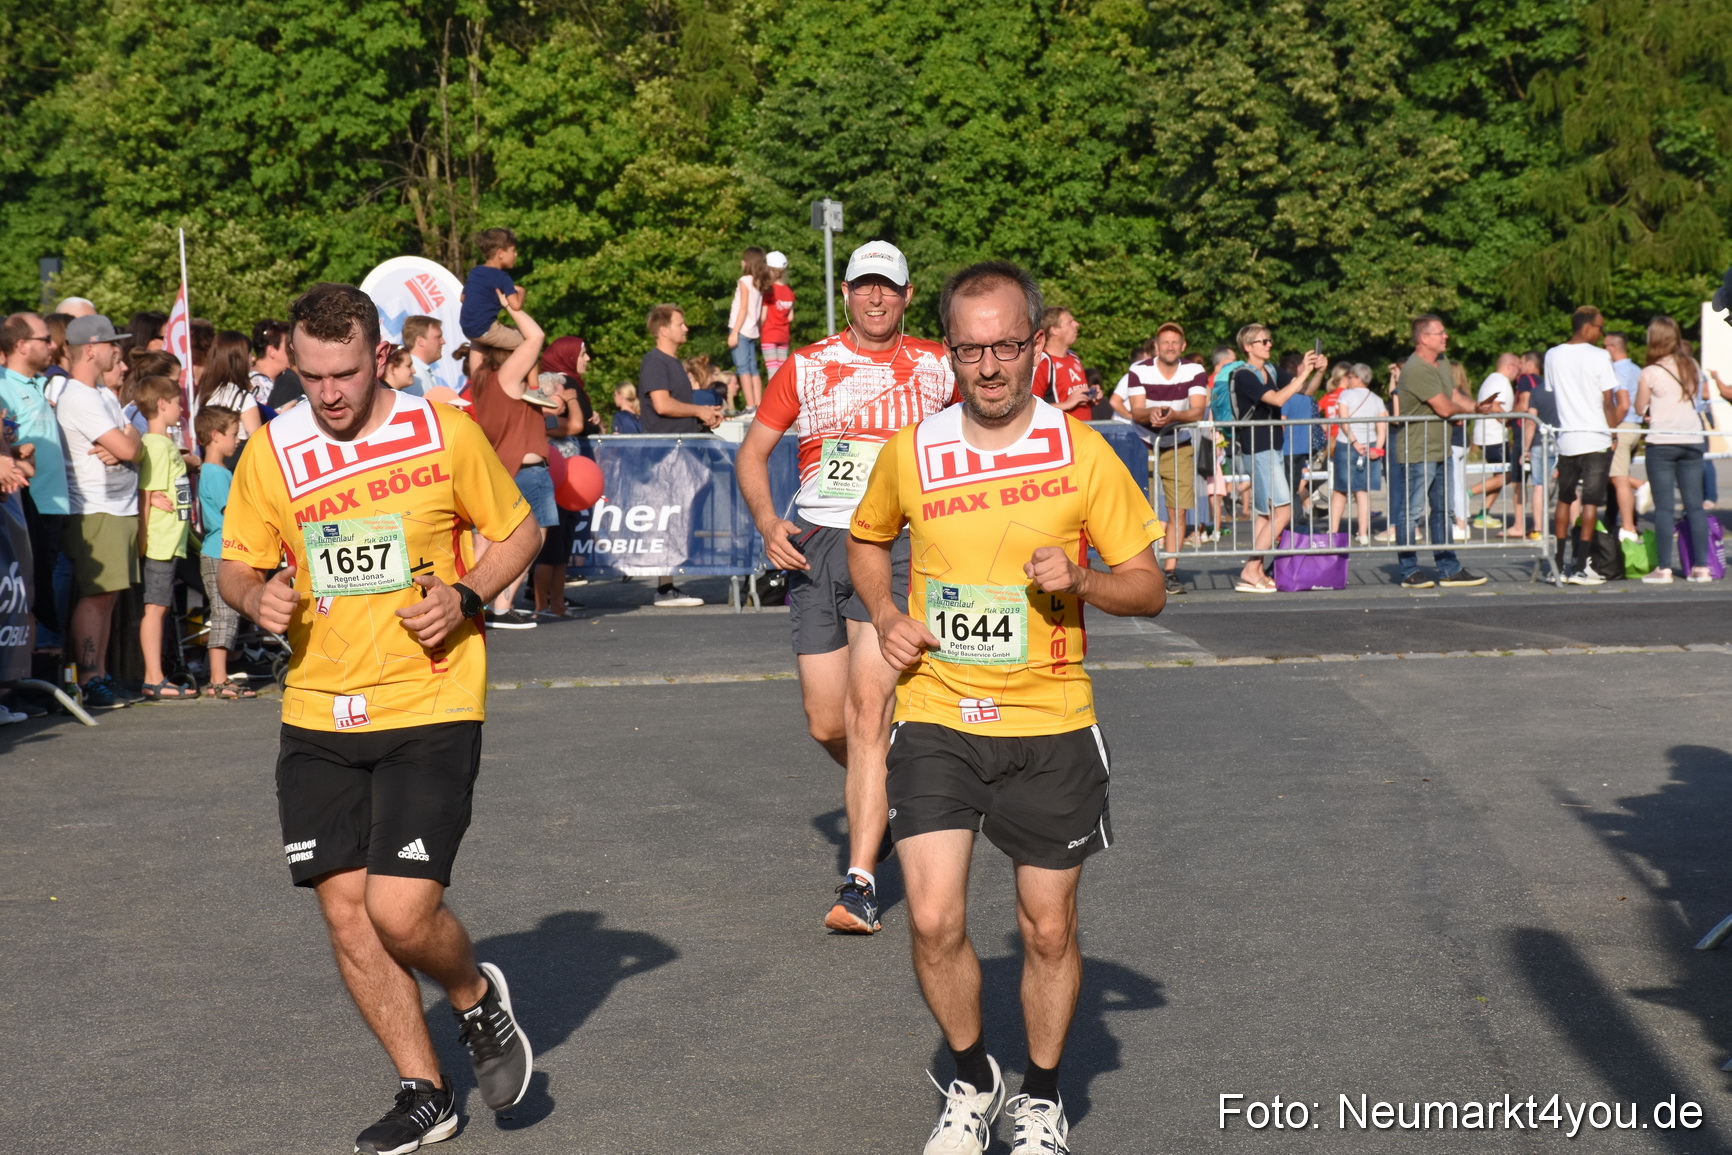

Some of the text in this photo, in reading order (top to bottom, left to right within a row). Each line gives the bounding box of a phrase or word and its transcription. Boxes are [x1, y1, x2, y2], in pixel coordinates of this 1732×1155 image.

[294, 463, 451, 531] MAX BÖGL
[922, 475, 1079, 522] MAX BÖGL
[378, 534, 398, 543] 2019
[319, 542, 392, 575] 1657
[333, 573, 385, 584] Regnet Jonas
[337, 582, 349, 590] Bögl
[935, 610, 1014, 643] 1644
[950, 641, 995, 652] Peters Olaf
[947, 649, 960, 657] Bögl
[960, 651, 992, 659] Bauservice
[291, 850, 315, 863] HORSE
[397, 850, 430, 862] adidas
